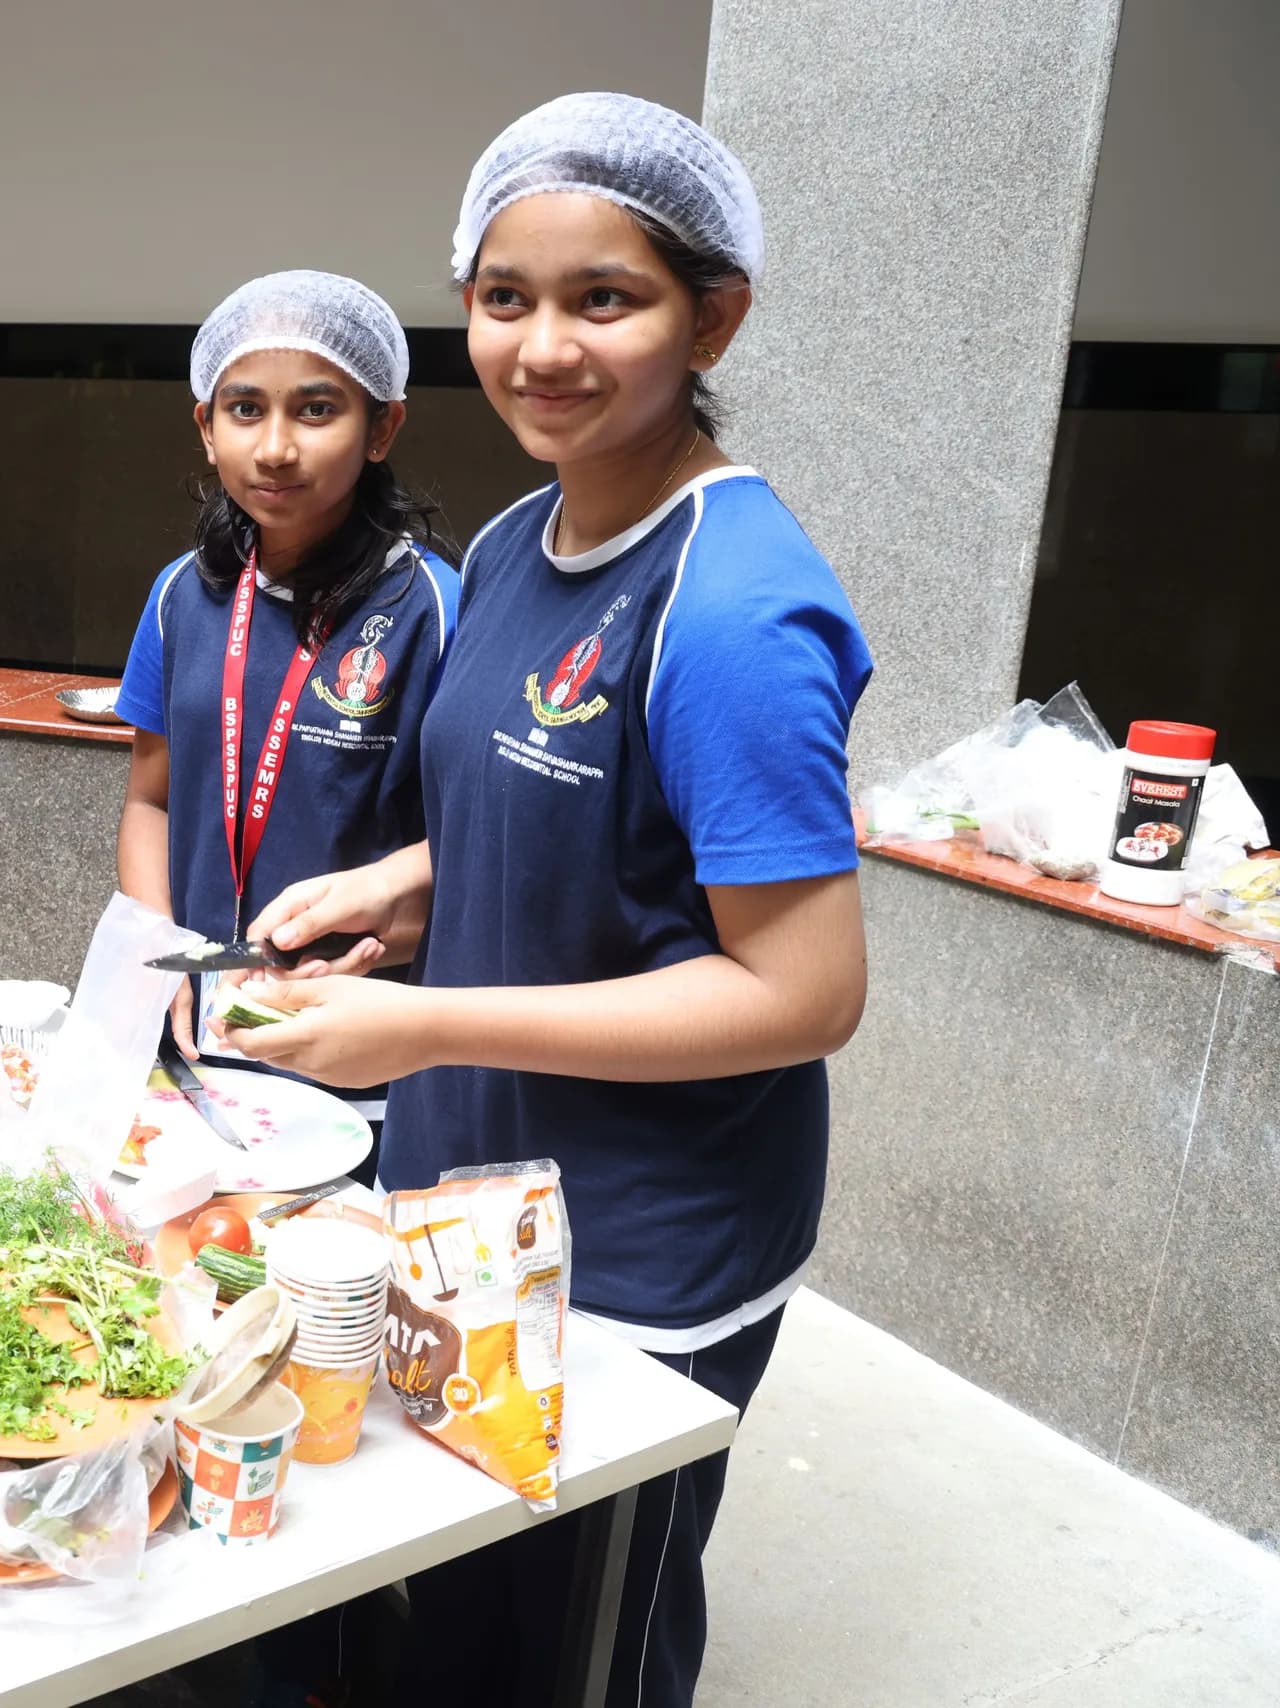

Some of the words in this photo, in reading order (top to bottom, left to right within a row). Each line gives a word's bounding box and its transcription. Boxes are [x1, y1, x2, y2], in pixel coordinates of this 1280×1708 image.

[225, 697, 238, 818] BSPSSPUC
[251, 700, 291, 818] PSSEMRS
[553, 769, 581, 785] SCHOOL
[1133, 782, 1185, 797] EVEREST
[1132, 795, 1153, 804] Chaat
[1154, 799, 1180, 808] Masala
[384, 1346, 433, 1394] alt
[508, 1349, 517, 1377] TATA
